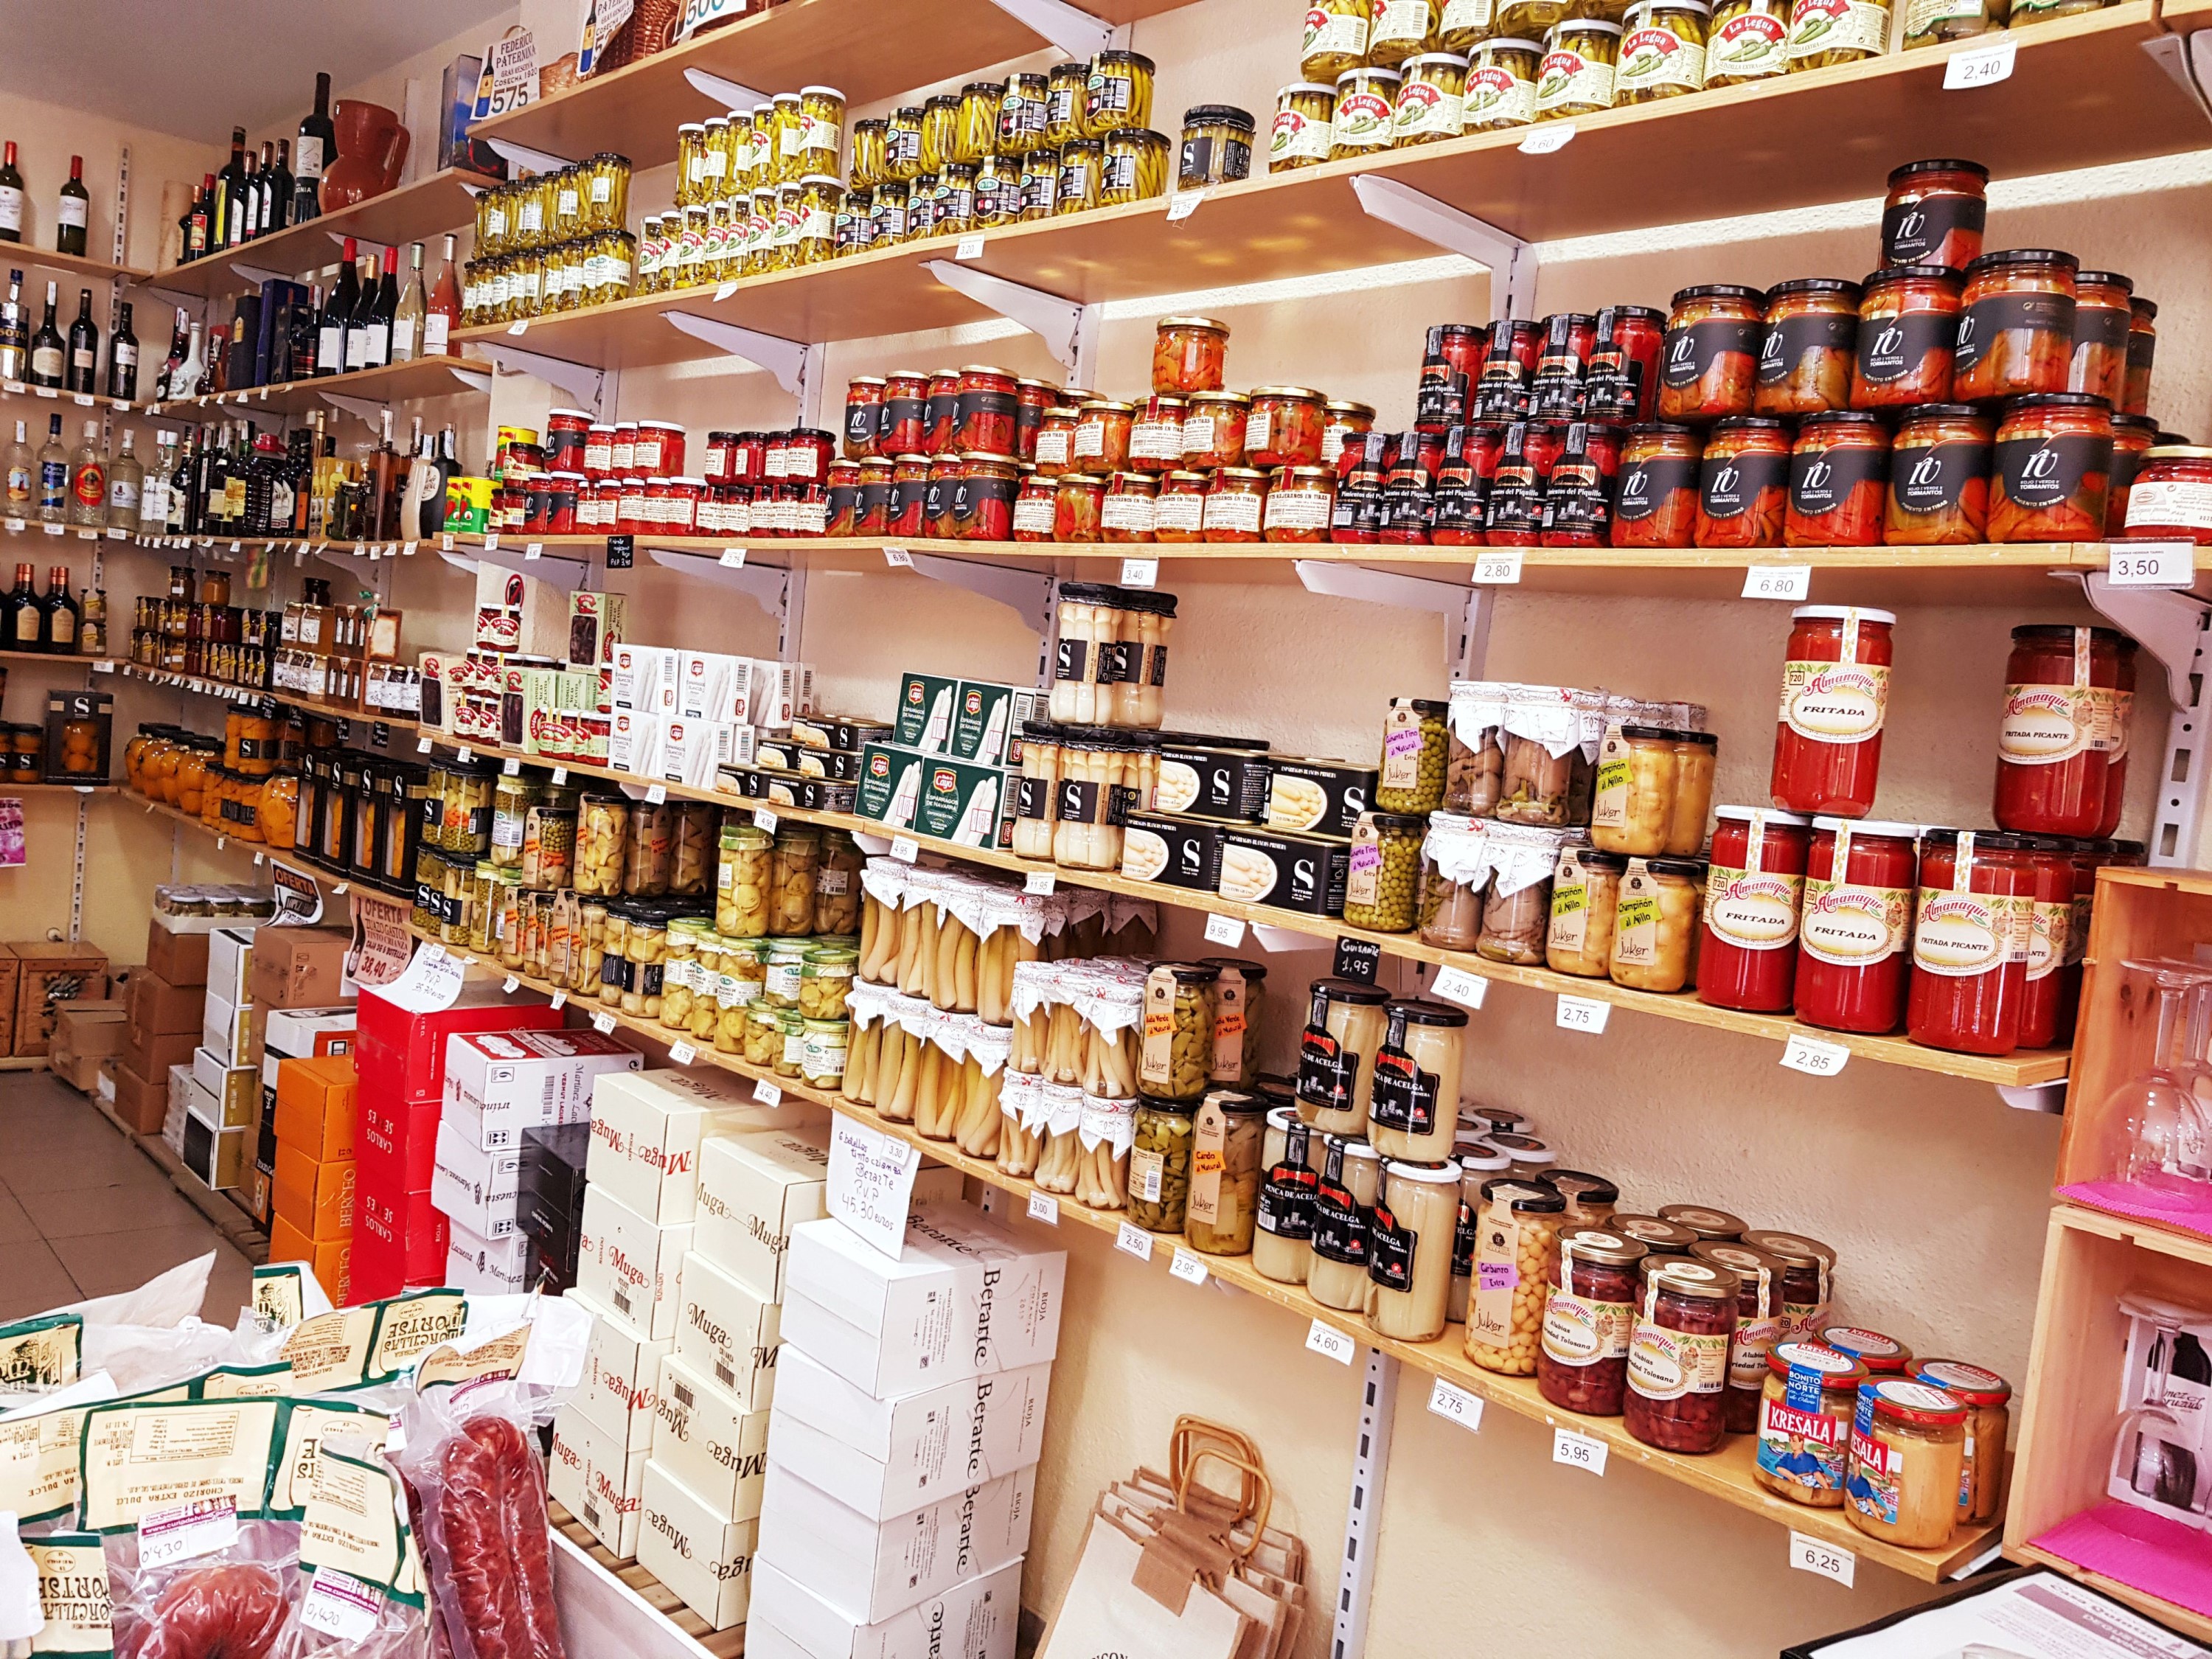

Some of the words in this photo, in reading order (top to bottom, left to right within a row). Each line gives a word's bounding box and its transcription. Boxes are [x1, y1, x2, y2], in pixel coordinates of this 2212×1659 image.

[501, 32, 533, 55] FEDERICO
[496, 45, 537, 69] PATERNINA
[1963, 60, 2000, 81] 2,40
[495, 74, 522, 87] COSECHA
[491, 83, 528, 113] 575
[1183, 143, 1194, 169] S
[1484, 565, 1510, 578] 2,80
[2118, 560, 2159, 578] 3,50
[1760, 580, 1793, 592] 6,80
[1790, 672, 1802, 684] 720
[1802, 671, 1875, 698] Almanaque
[1803, 706, 1866, 717] FRITADA
[2034, 731, 2070, 740] PICANTE
[872, 763, 886, 773] Cayo
[935, 777, 953, 789] Cayo
[1212, 769, 1230, 796] S
[1064, 784, 1082, 808] S
[1596, 800, 1620, 821] juker
[1182, 839, 1200, 867] S
[1293, 859, 1314, 888] S
[276, 871, 316, 896] OFERTA
[1714, 879, 1725, 888] 720
[1721, 880, 1791, 901] Almanaque
[365, 898, 403, 923] OFERTA
[1812, 892, 1883, 914] Almanaque
[1920, 900, 1989, 923] Almanaque
[1726, 912, 1786, 925] FRITADA
[1551, 923, 1577, 943] juker
[1815, 926, 1877, 940] FRITADA
[1340, 939, 1380, 955] GUISANTE
[1619, 937, 1649, 958] juker
[1921, 936, 1948, 947] FRITADA
[1951, 942, 1989, 951] PICANTE
[361, 956, 386, 978] 38,40
[1342, 959, 1370, 975] 1,95
[1442, 979, 1470, 997] 2,40
[1564, 1007, 1589, 1025] 2,75
[1307, 1054, 1314, 1062] DE
[1315, 1057, 1343, 1069] ACELGA
[1795, 1051, 1830, 1070] 2,85
[1384, 1076, 1391, 1085] DE
[1393, 1079, 1423, 1091] ACELGA
[366, 1128, 392, 1154] CARLOS
[839, 1131, 843, 1141] 6
[844, 1133, 868, 1152] botellas
[639, 1144, 692, 1176] Muga
[851, 1149, 869, 1162] tinto
[1196, 1152, 1215, 1161] Cardo
[339, 1168, 355, 1231] BERCEO
[1265, 1184, 1284, 1197] PENCA
[1033, 1203, 1048, 1216] 3,00
[1323, 1208, 1329, 1216] DE
[1330, 1211, 1360, 1223] ACELGA
[365, 1215, 392, 1243] CARLOS
[875, 1213, 894, 1231] euros
[748, 1213, 790, 1255] Muga
[1126, 1235, 1144, 1251] 2,50
[1377, 1231, 1400, 1247] ACELGA
[609, 1246, 650, 1289] Muga
[1175, 1259, 1194, 1276] 2,95
[1481, 1263, 1509, 1275] Garbanzo
[1039, 1291, 1049, 1321] RIOJA
[688, 1302, 732, 1349] Muga
[973, 1267, 1001, 1367] Berarte
[1475, 1308, 1505, 1332] juker
[1550, 1319, 1571, 1334] Alubias
[1313, 1333, 1338, 1352] 4,60
[1560, 1335, 1591, 1350] Tolosana
[1800, 1343, 1840, 1359] KRESALA
[1633, 1352, 1653, 1366] Alubias
[1644, 1368, 1674, 1383] Tolosana
[1789, 1371, 1820, 1385] BONITO
[602, 1371, 656, 1411] Muga
[1788, 1381, 1820, 1394] NORTE
[1025, 1398, 1034, 1427] RIOJA
[1436, 1392, 1464, 1414] 2,75
[967, 1380, 992, 1480] Berarte
[1770, 1405, 1830, 1444] KRESALA
[706, 1440, 767, 1479] Muga
[1560, 1443, 1590, 1463] 5,95
[148, 1492, 177, 1501] EXTRA
[184, 1487, 223, 1498] CHORIZO
[644, 1509, 692, 1559] Muga
[956, 1483, 981, 1576] Berarte
[1806, 1550, 1840, 1573] 6,25
